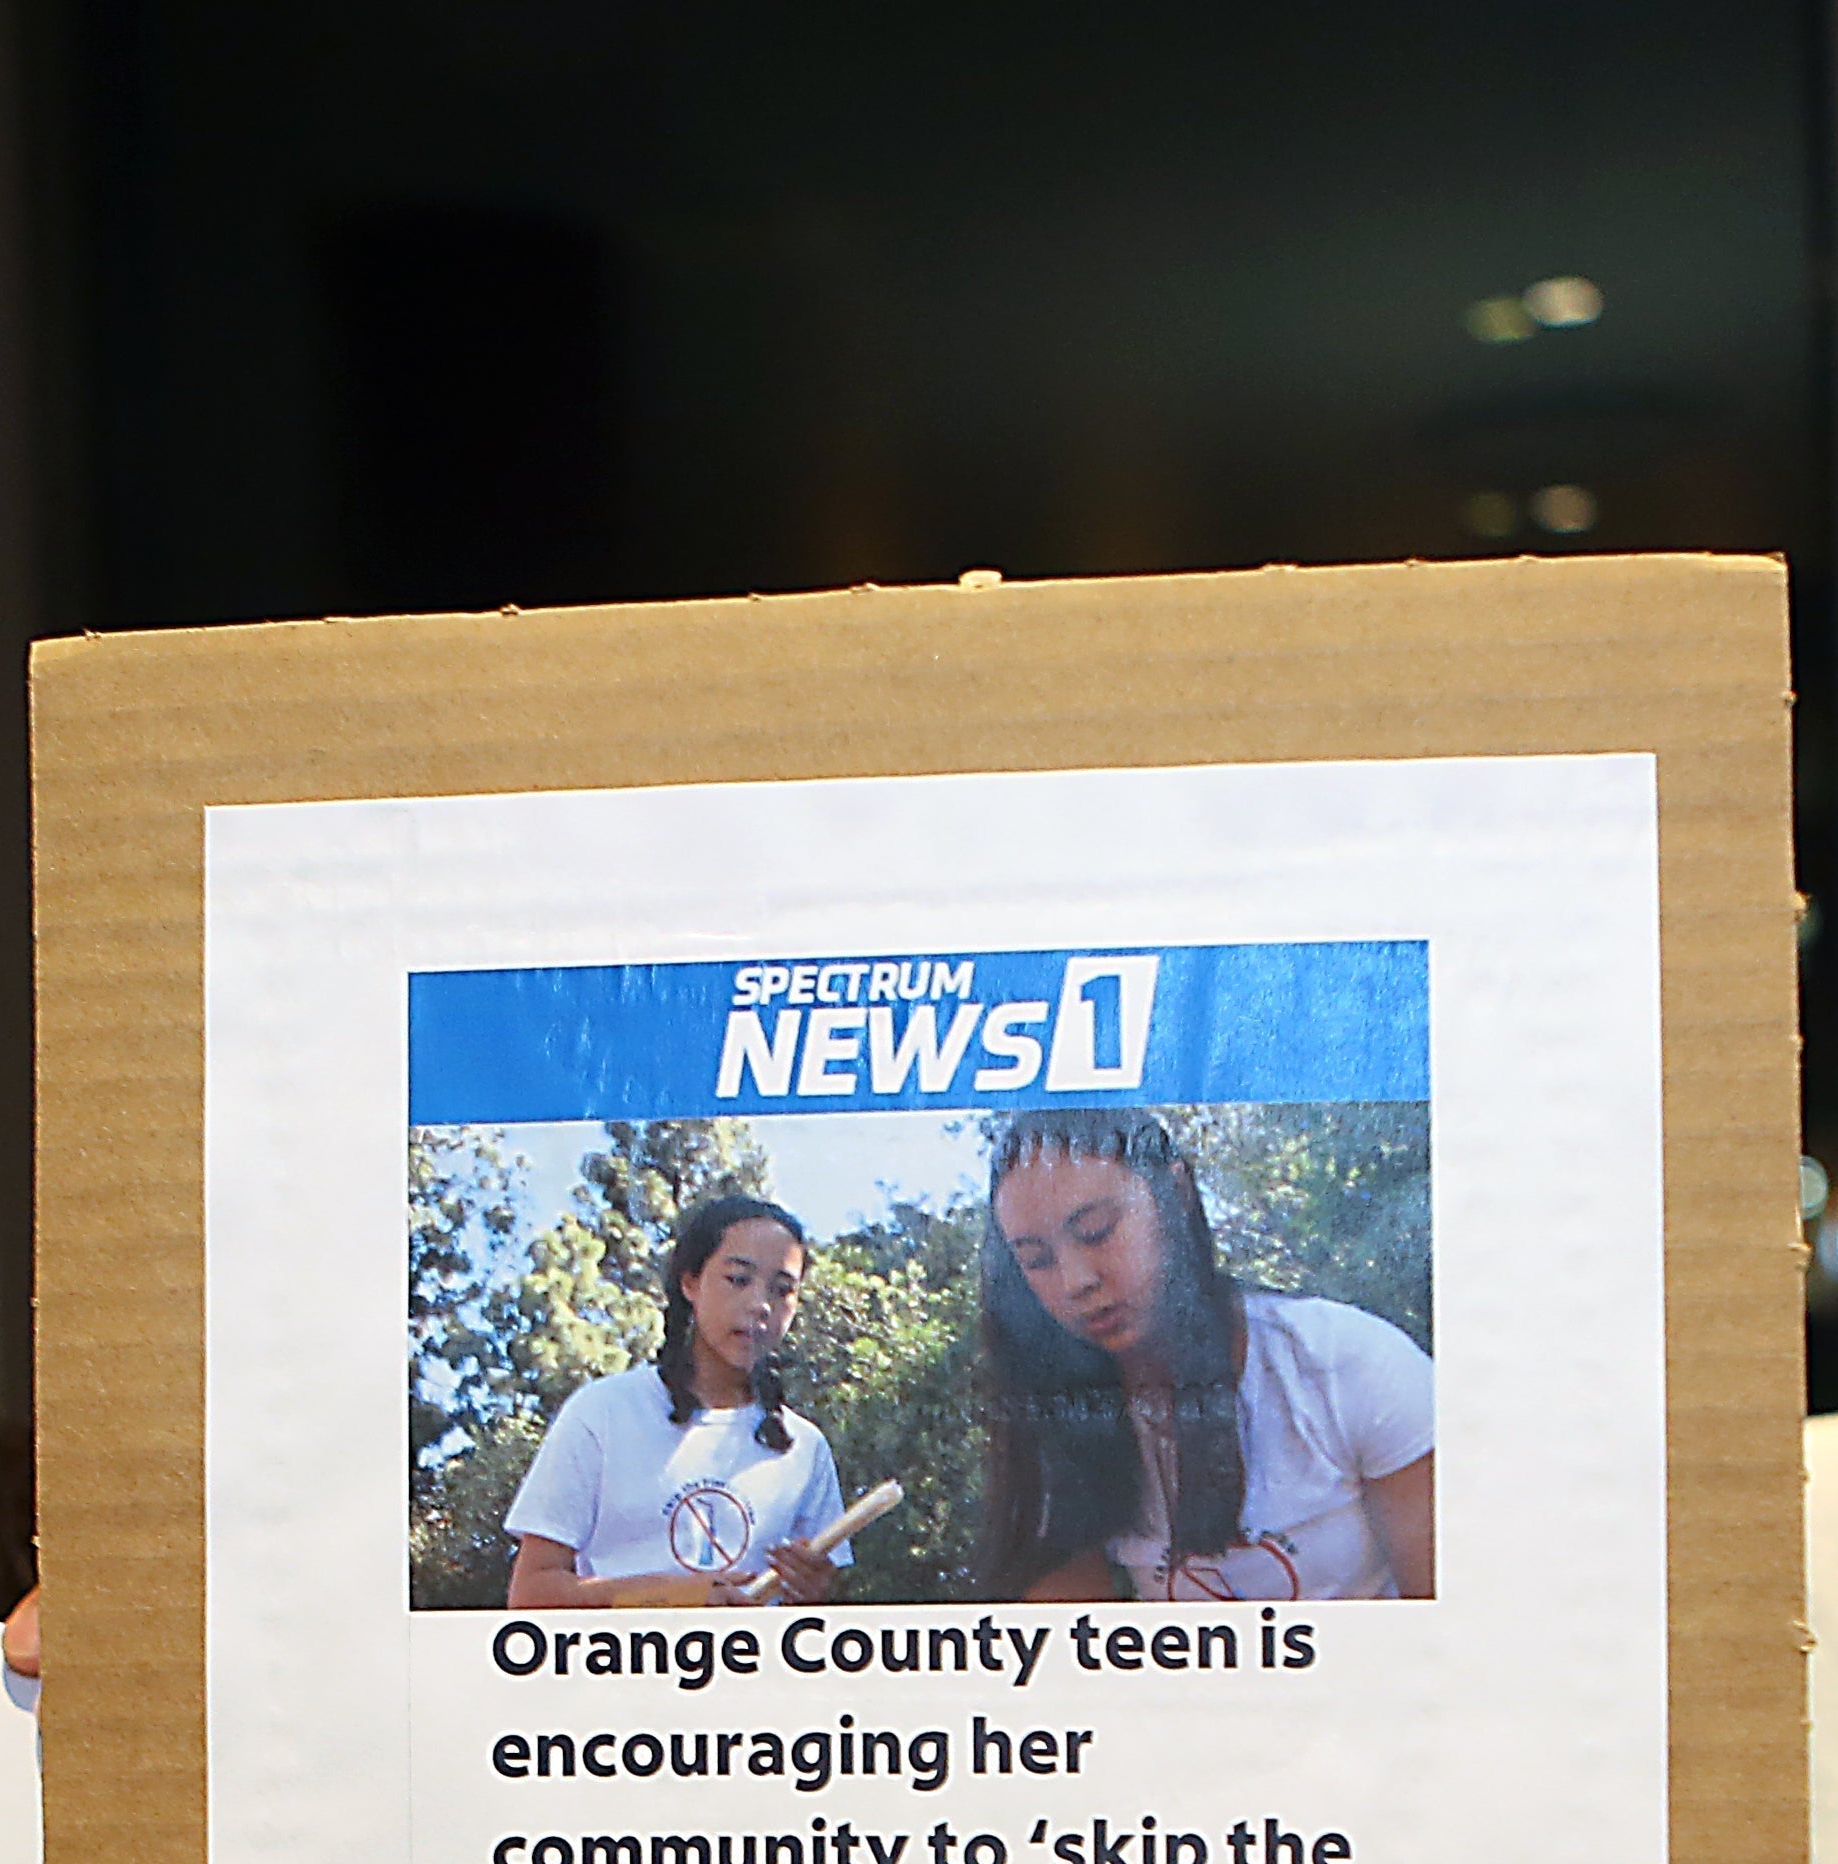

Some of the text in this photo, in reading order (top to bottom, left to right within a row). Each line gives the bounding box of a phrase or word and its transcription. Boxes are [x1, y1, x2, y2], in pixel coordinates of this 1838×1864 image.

[733, 961, 973, 1005] SPECTRUM
[492, 1609, 1316, 1689] Orange County teen is
[492, 1714, 1093, 1792] encouraging her
